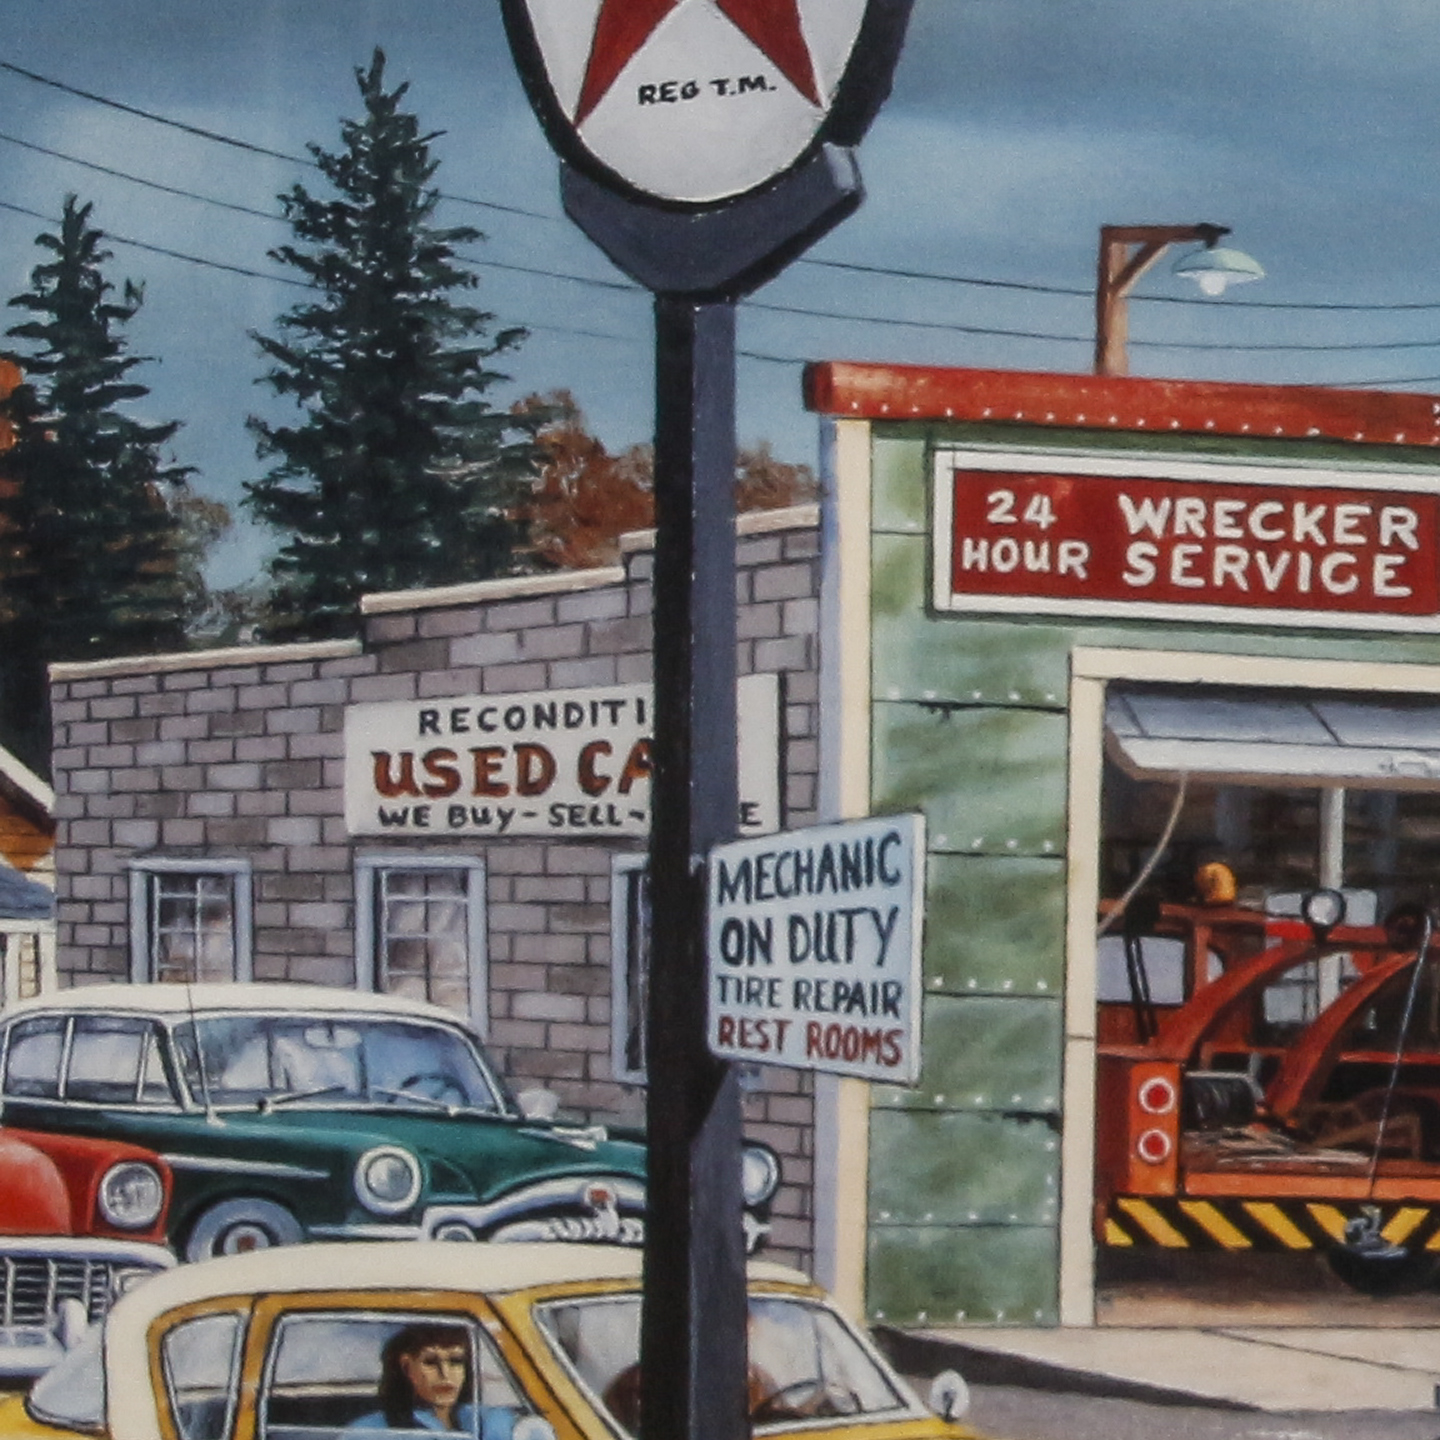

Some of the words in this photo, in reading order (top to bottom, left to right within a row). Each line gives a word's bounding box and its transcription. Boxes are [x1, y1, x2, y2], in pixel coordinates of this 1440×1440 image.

[638, 78, 700, 106] REG
[710, 75, 778, 98] T.M.
[986, 491, 1056, 528] 24
[1117, 492, 1420, 552] WRECKER
[962, 538, 1091, 579] HOUR
[1121, 544, 1413, 599] SERVICE
[418, 697, 646, 736] RECONDITI
[370, 741, 558, 799] USED
[577, 737, 655, 798] CA
[378, 803, 430, 828] WE
[717, 833, 903, 908] MECHANIC
[719, 912, 774, 969] ON
[788, 904, 901, 969] DUTY
[717, 975, 783, 1009] TIRE
[793, 977, 902, 1020] REPAIR
[718, 1018, 788, 1055] REST
[806, 1024, 903, 1066] ROOMS
